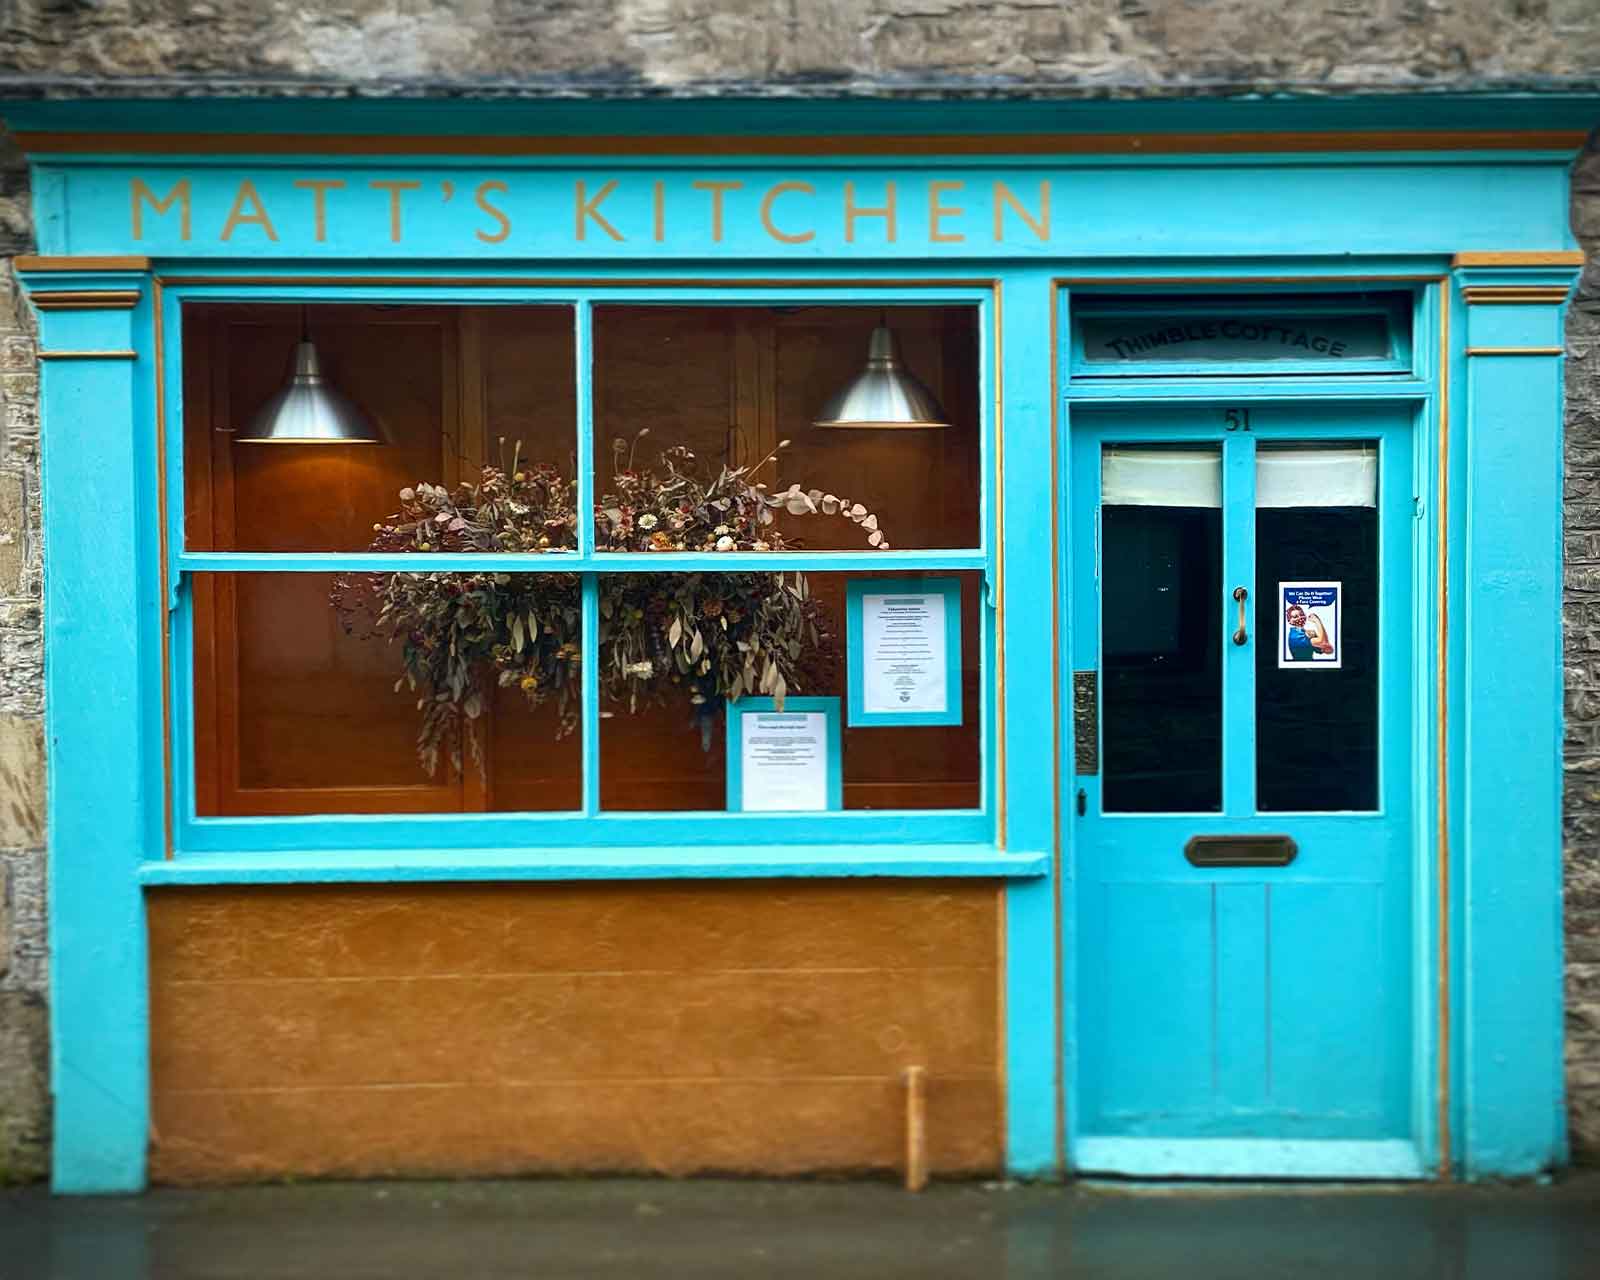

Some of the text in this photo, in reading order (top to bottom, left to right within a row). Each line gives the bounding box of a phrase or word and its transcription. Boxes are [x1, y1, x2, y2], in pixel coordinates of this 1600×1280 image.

[575, 180, 1051, 244] KITCHEN
[1104, 319, 1348, 360] THIMBLE COTTAGE
[1224, 408, 1252, 432] 51
